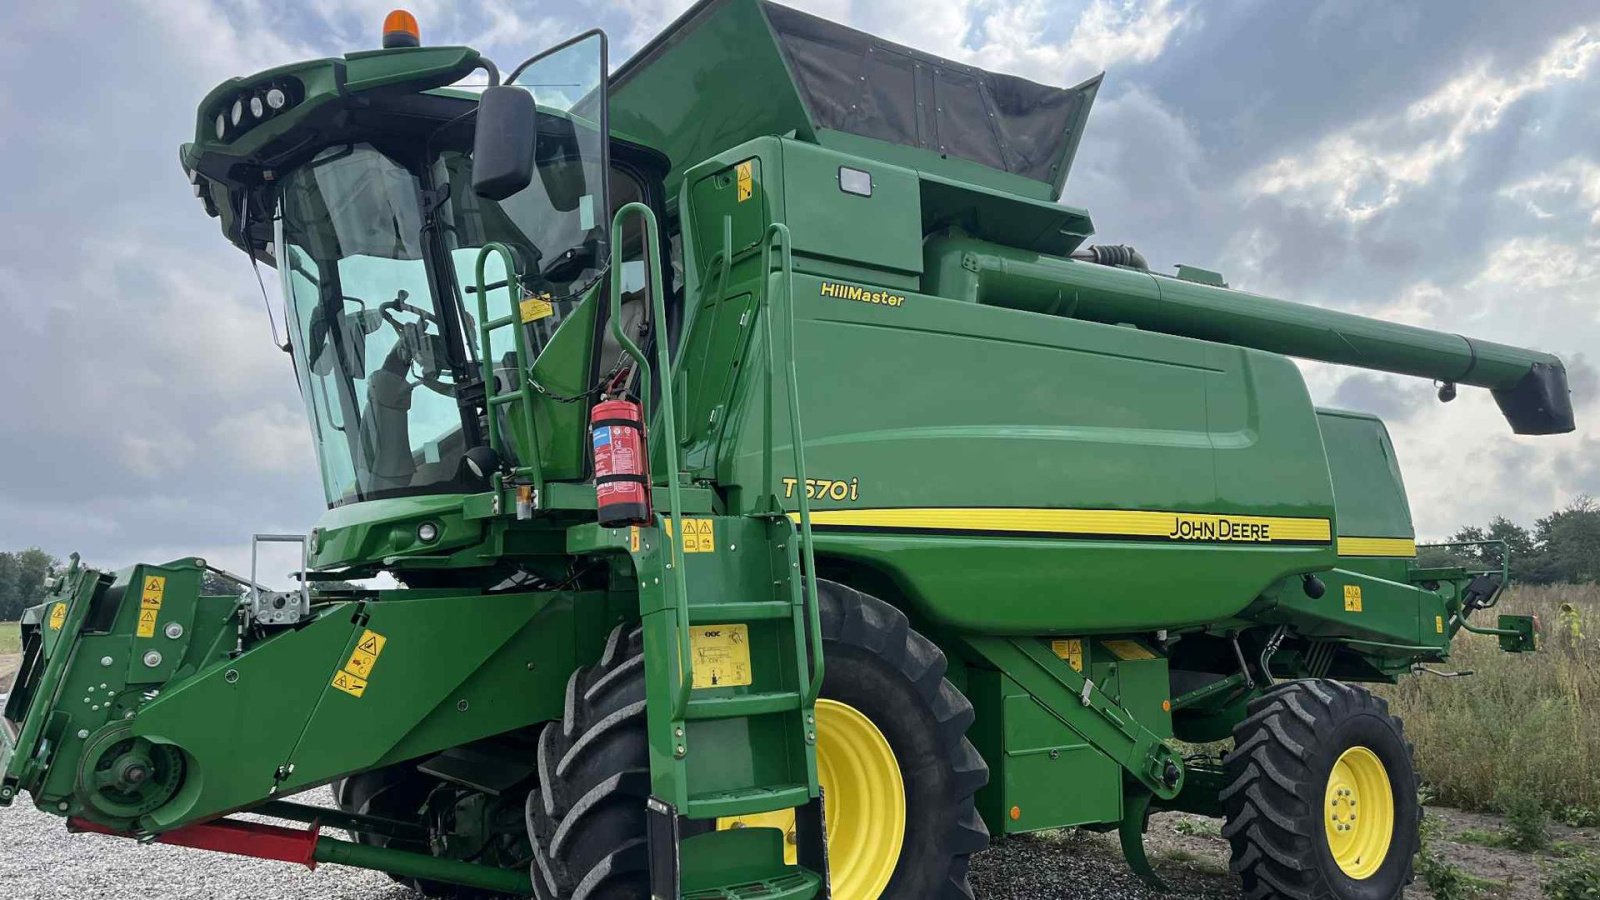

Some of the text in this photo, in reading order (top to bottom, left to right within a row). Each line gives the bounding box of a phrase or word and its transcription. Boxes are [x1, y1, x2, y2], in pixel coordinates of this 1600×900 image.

[820, 281, 904, 306] HillMaster
[1170, 516, 1270, 540] JOHN DEERE
